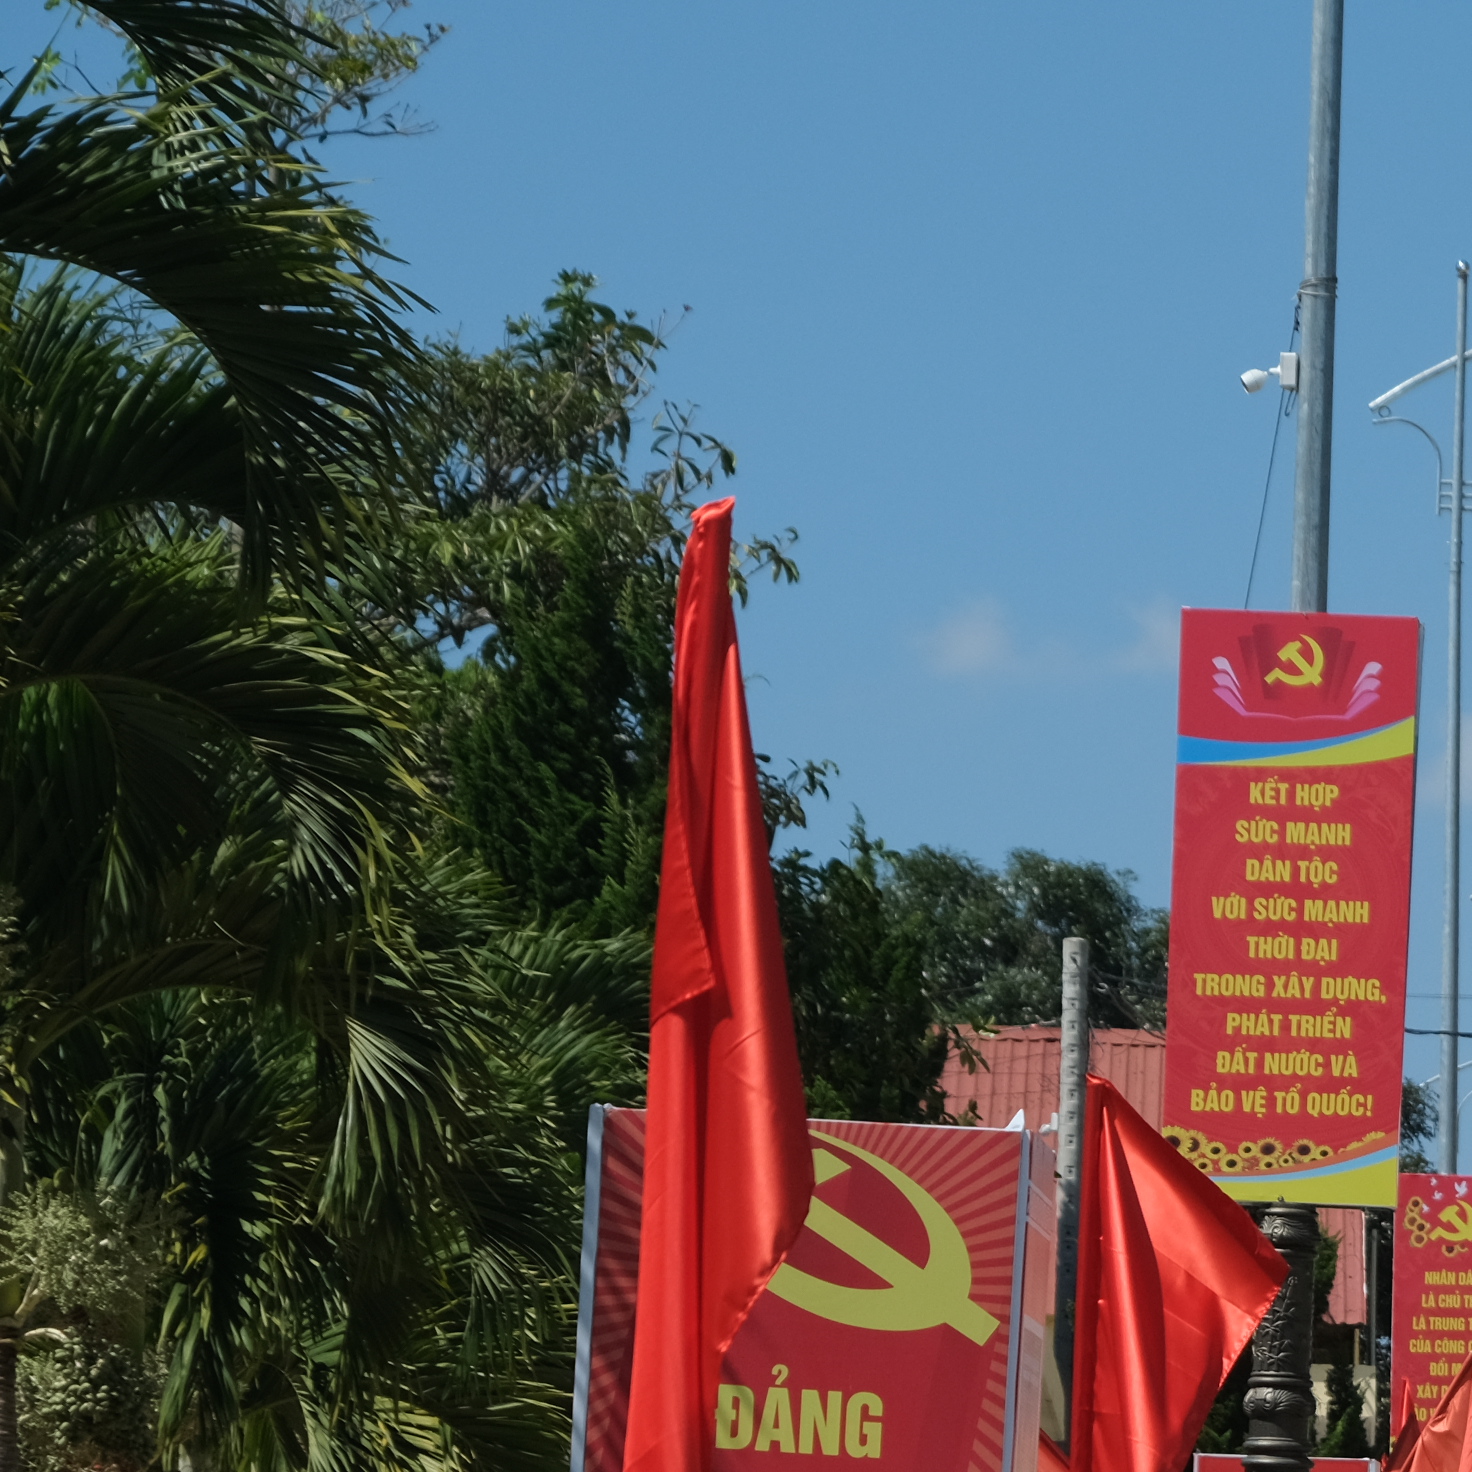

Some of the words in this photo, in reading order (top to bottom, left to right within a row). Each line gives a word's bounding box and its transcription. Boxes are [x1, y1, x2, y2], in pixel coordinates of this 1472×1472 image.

[1249, 775, 1289, 805] KẾT
[1295, 781, 1339, 811] HỢP
[1235, 815, 1279, 843] SỨC
[1285, 821, 1351, 849] MẠNH
[1245, 854, 1291, 882] DÂN
[1297, 856, 1338, 888] TỘC
[1211, 892, 1247, 919] VỚI
[1253, 893, 1297, 921] SỨC
[1303, 899, 1369, 927] MẠNH
[1246, 931, 1295, 959] THỜI
[1301, 937, 1338, 966] ĐẠI
[1193, 972, 1265, 997] TRONG
[1271, 971, 1314, 998] XÂY
[1320, 975, 1387, 1005] DỰNG,
[1226, 1008, 1282, 1036] PHÁT
[1288, 1006, 1352, 1039] TRIỂN
[1215, 1043, 1258, 1074] ĐẤT
[1263, 1048, 1324, 1077] NƯỚC
[1330, 1050, 1358, 1078] VÀ
[1190, 1081, 1235, 1112] BẢO
[1241, 1085, 1267, 1118] VỆ
[1274, 1083, 1302, 1114] TỔ
[1306, 1085, 1373, 1118] QUỐC!
[1424, 1268, 1456, 1285] NHÂN
[1421, 1290, 1435, 1308] LÀ
[1438, 1290, 1460, 1308] CHỦ
[1412, 1313, 1426, 1330] LÀ
[1428, 1316, 1466, 1331] TRUNG
[1409, 1334, 1431, 1353] CỦA
[1434, 1336, 1466, 1354] CÔNG
[1416, 1382, 1438, 1399] XÂY
[714, 1363, 884, 1459] ĐẢNG
